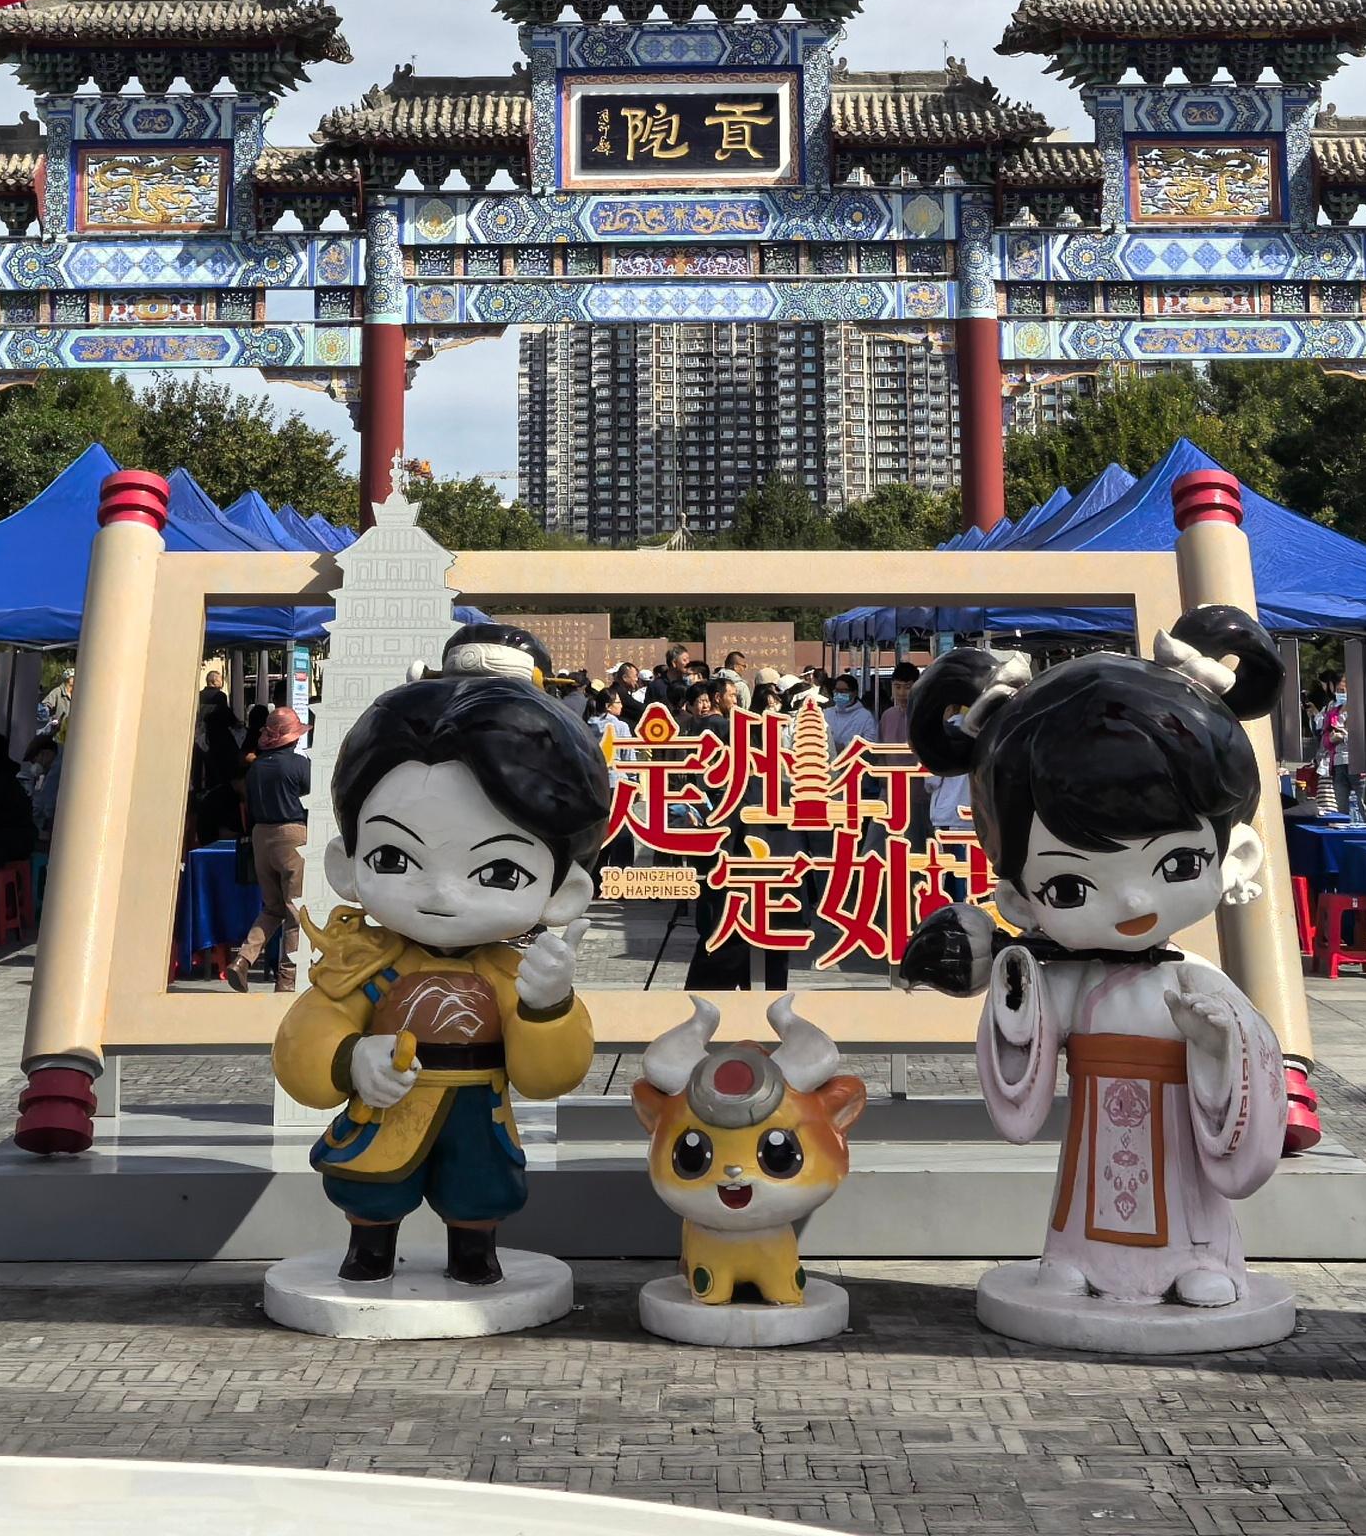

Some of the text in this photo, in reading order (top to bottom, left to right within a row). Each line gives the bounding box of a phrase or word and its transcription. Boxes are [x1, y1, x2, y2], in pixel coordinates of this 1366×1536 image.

[600, 695, 933, 856] 定州行
[603, 870, 694, 882] TO DINGZHOU
[603, 885, 697, 896] TO HAPPINESS
